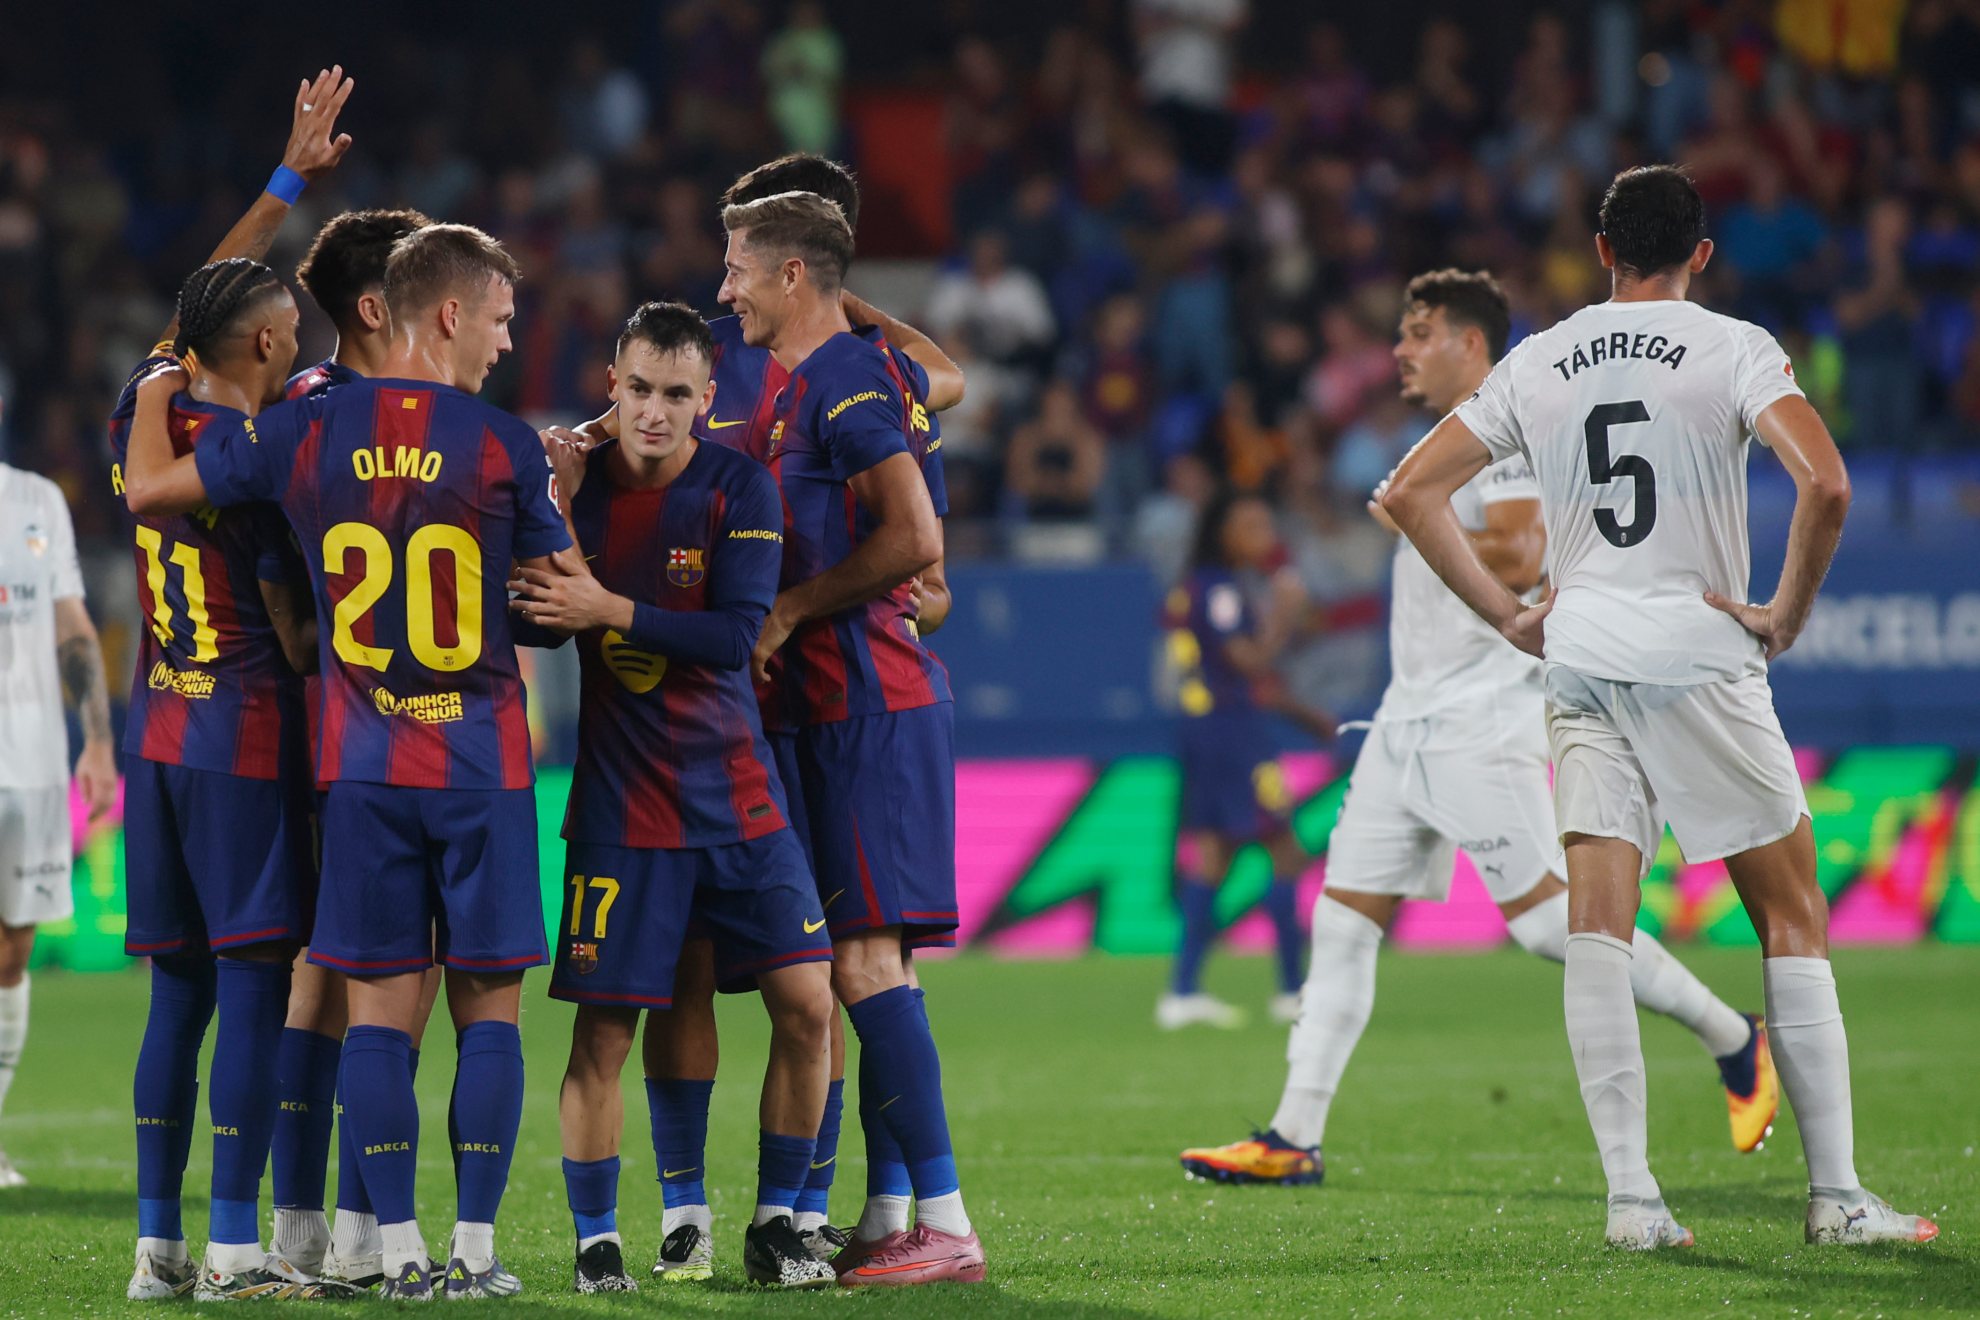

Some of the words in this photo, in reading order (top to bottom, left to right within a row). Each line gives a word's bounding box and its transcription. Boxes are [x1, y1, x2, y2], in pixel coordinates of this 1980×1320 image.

[1553, 332, 1687, 381] TÁRREGA
[827, 391, 878, 421] AMBILIGHT
[352, 445, 442, 483] OLMO
[1584, 400, 1657, 548] 5
[136, 524, 219, 663] 11
[322, 521, 482, 672] 20
[401, 692, 461, 710] UNHCR
[412, 705, 463, 720] CNUR
[570, 875, 620, 938] 17
[365, 1142, 409, 1155] BARÇA
[456, 1143, 500, 1153] BARÇA
